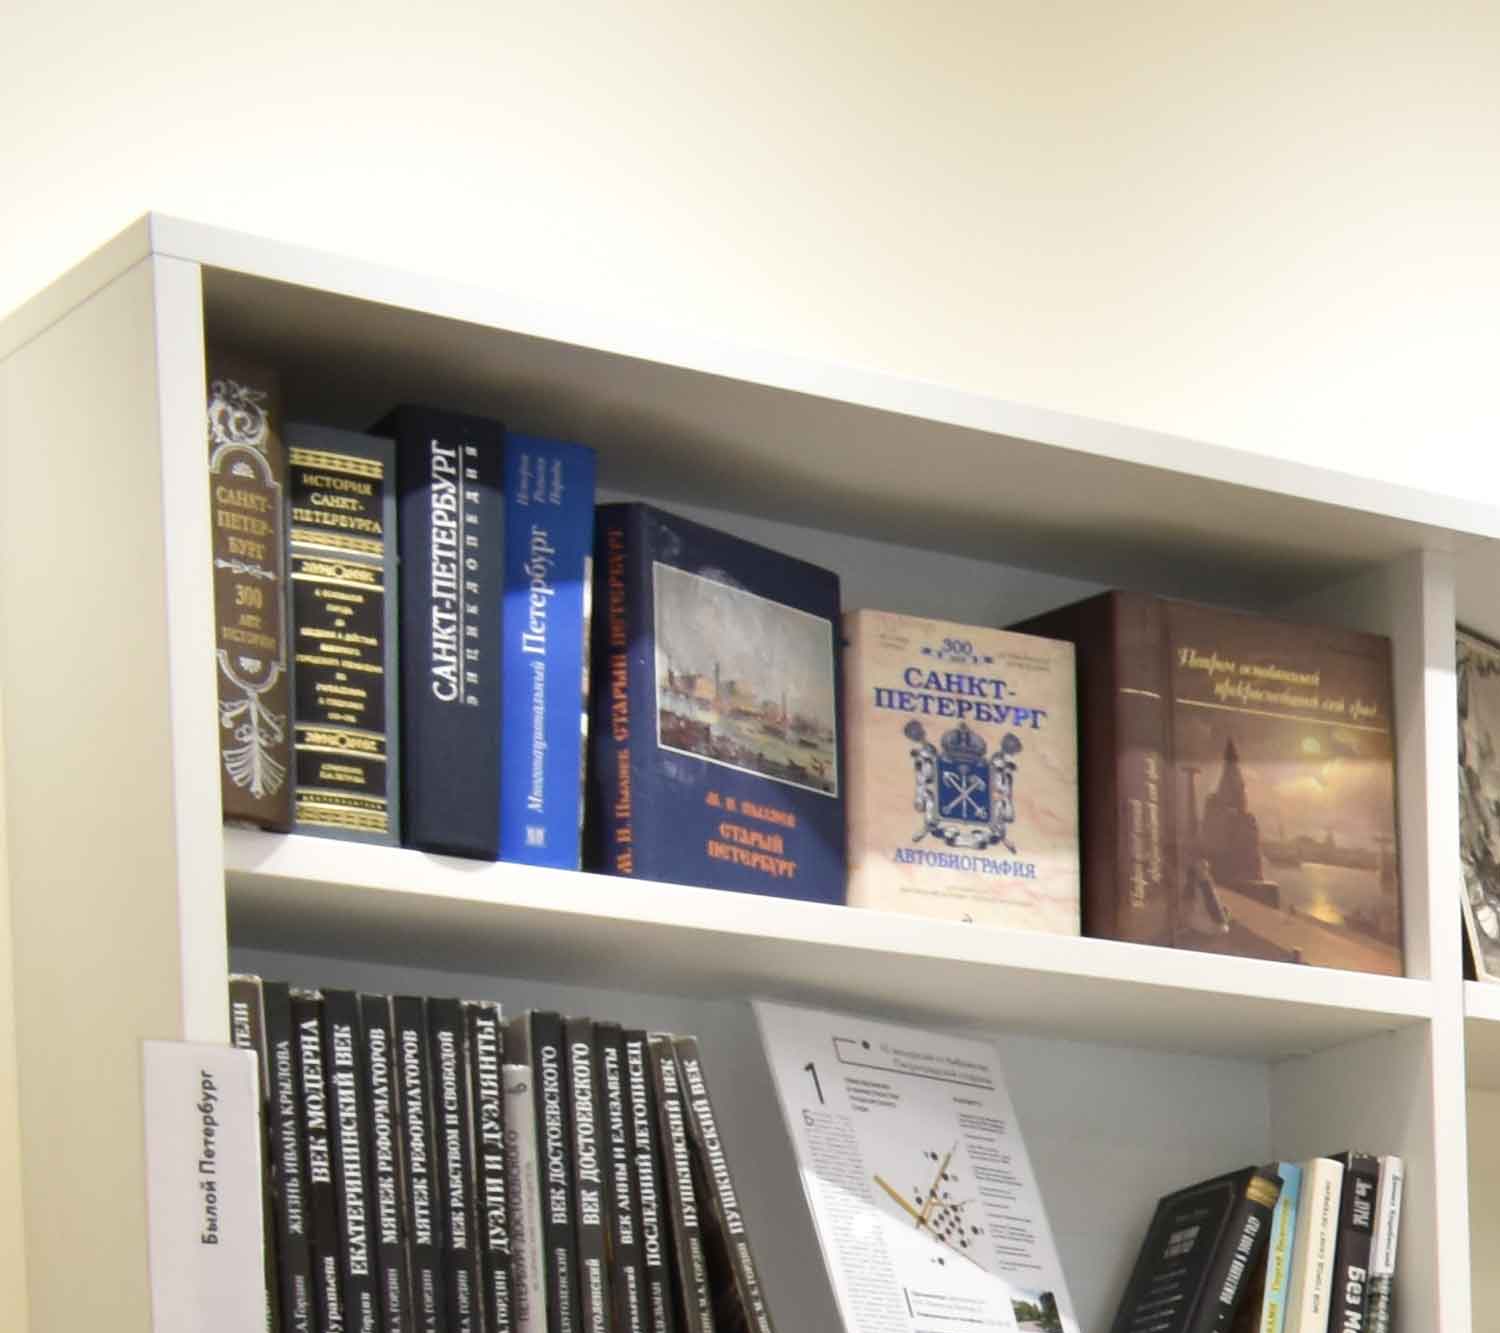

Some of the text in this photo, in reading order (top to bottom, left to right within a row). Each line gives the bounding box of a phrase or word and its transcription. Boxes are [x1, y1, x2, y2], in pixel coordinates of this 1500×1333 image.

[303, 473, 372, 496] ИСТОРИЯ
[310, 492, 365, 511] САНКТ-
[430, 439, 458, 702] САНКТ-ПЕТЕРБУРГ
[522, 525, 556, 656] Петербург
[874, 688, 1047, 729] ПЕТЕРБУРГ
[904, 667, 1016, 700] САНКТ-
[894, 847, 1037, 879] АВТОБИОГРАФИЯ
[196, 1068, 218, 1245] Былой Петербург
[298, 1017, 334, 1185] ВЕК МОДЕРНА
[330, 1021, 371, 1277] ЕКАТЕРИНИНСКИЙ ВЕК
[367, 1025, 399, 1245] МЯТЕЖ РЕФОРМАТОРОВ
[400, 1029, 434, 1245] МЯТЕЖ РЕФОРМАТОРОВ
[436, 1030, 469, 1250] МЕЖ РАБСТВОМ СВОБОДОЙ
[472, 1014, 511, 1256] ДУЭЛИ ДУЭЛЯНТЫ
[540, 1044, 570, 1225] ВЕК ДОСТОЕВСКОГО
[570, 1041, 601, 1225] ВЕК ДОСТОЕВСКОГО
[626, 1039, 662, 1266] ПОСЛЕДНИЙ ЛЕТОПИСЕЦ
[666, 1098, 699, 1229] ПУШКИНСКИЙ
[681, 1055, 745, 1236] ПУШКИНСКИЙ ВЕК
[804, 1061, 825, 1104] 1
[616, 1213, 634, 1244] ВЕК
[1345, 1265, 1366, 1304] Без
